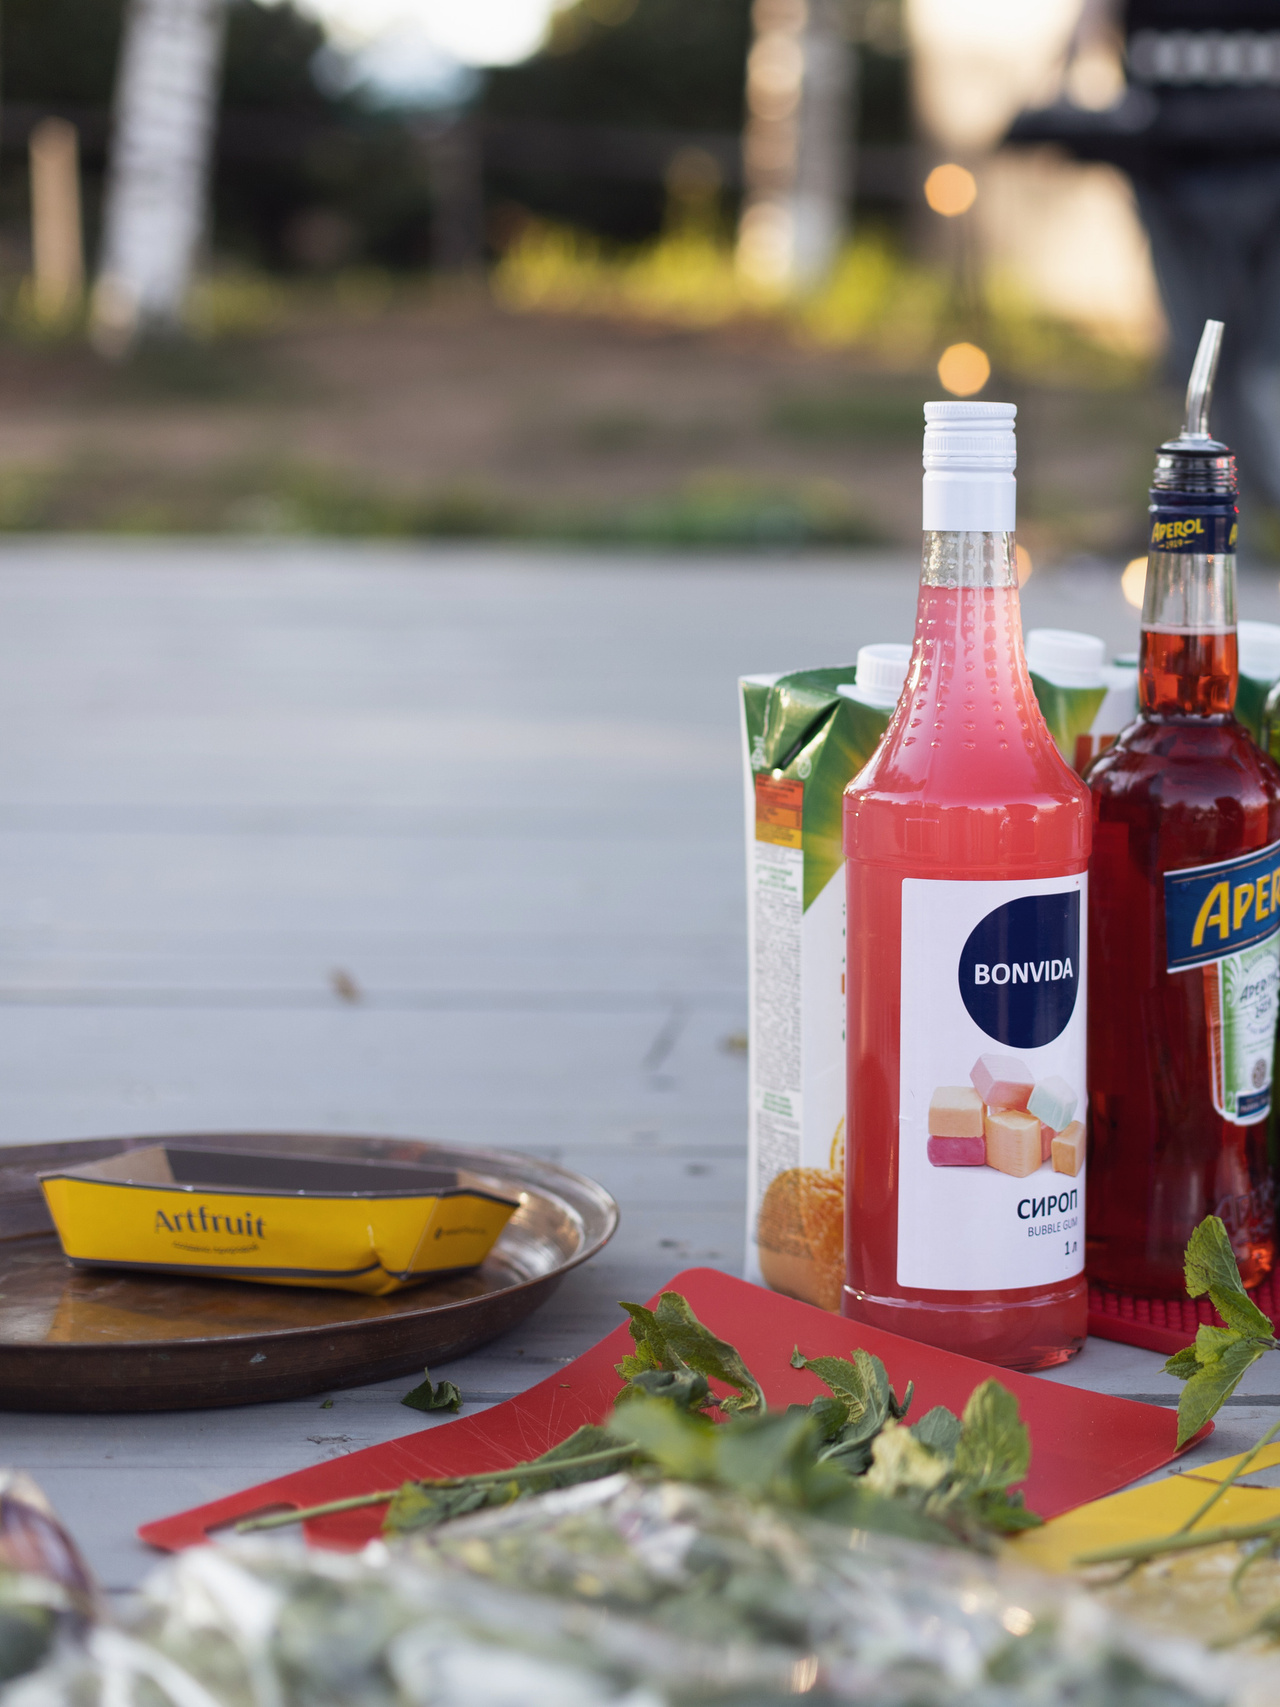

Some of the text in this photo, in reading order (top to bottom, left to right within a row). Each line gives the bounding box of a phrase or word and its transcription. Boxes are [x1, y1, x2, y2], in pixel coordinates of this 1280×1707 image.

[1151, 518, 1204, 543] APEROL
[975, 958, 1073, 985] BONVIDA
[1017, 1188, 1077, 1219] СИРОП
[155, 1205, 266, 1240] Artfruit
[1028, 1216, 1078, 1237] BUBBLE GUM
[1065, 1241, 1070, 1255] 1
